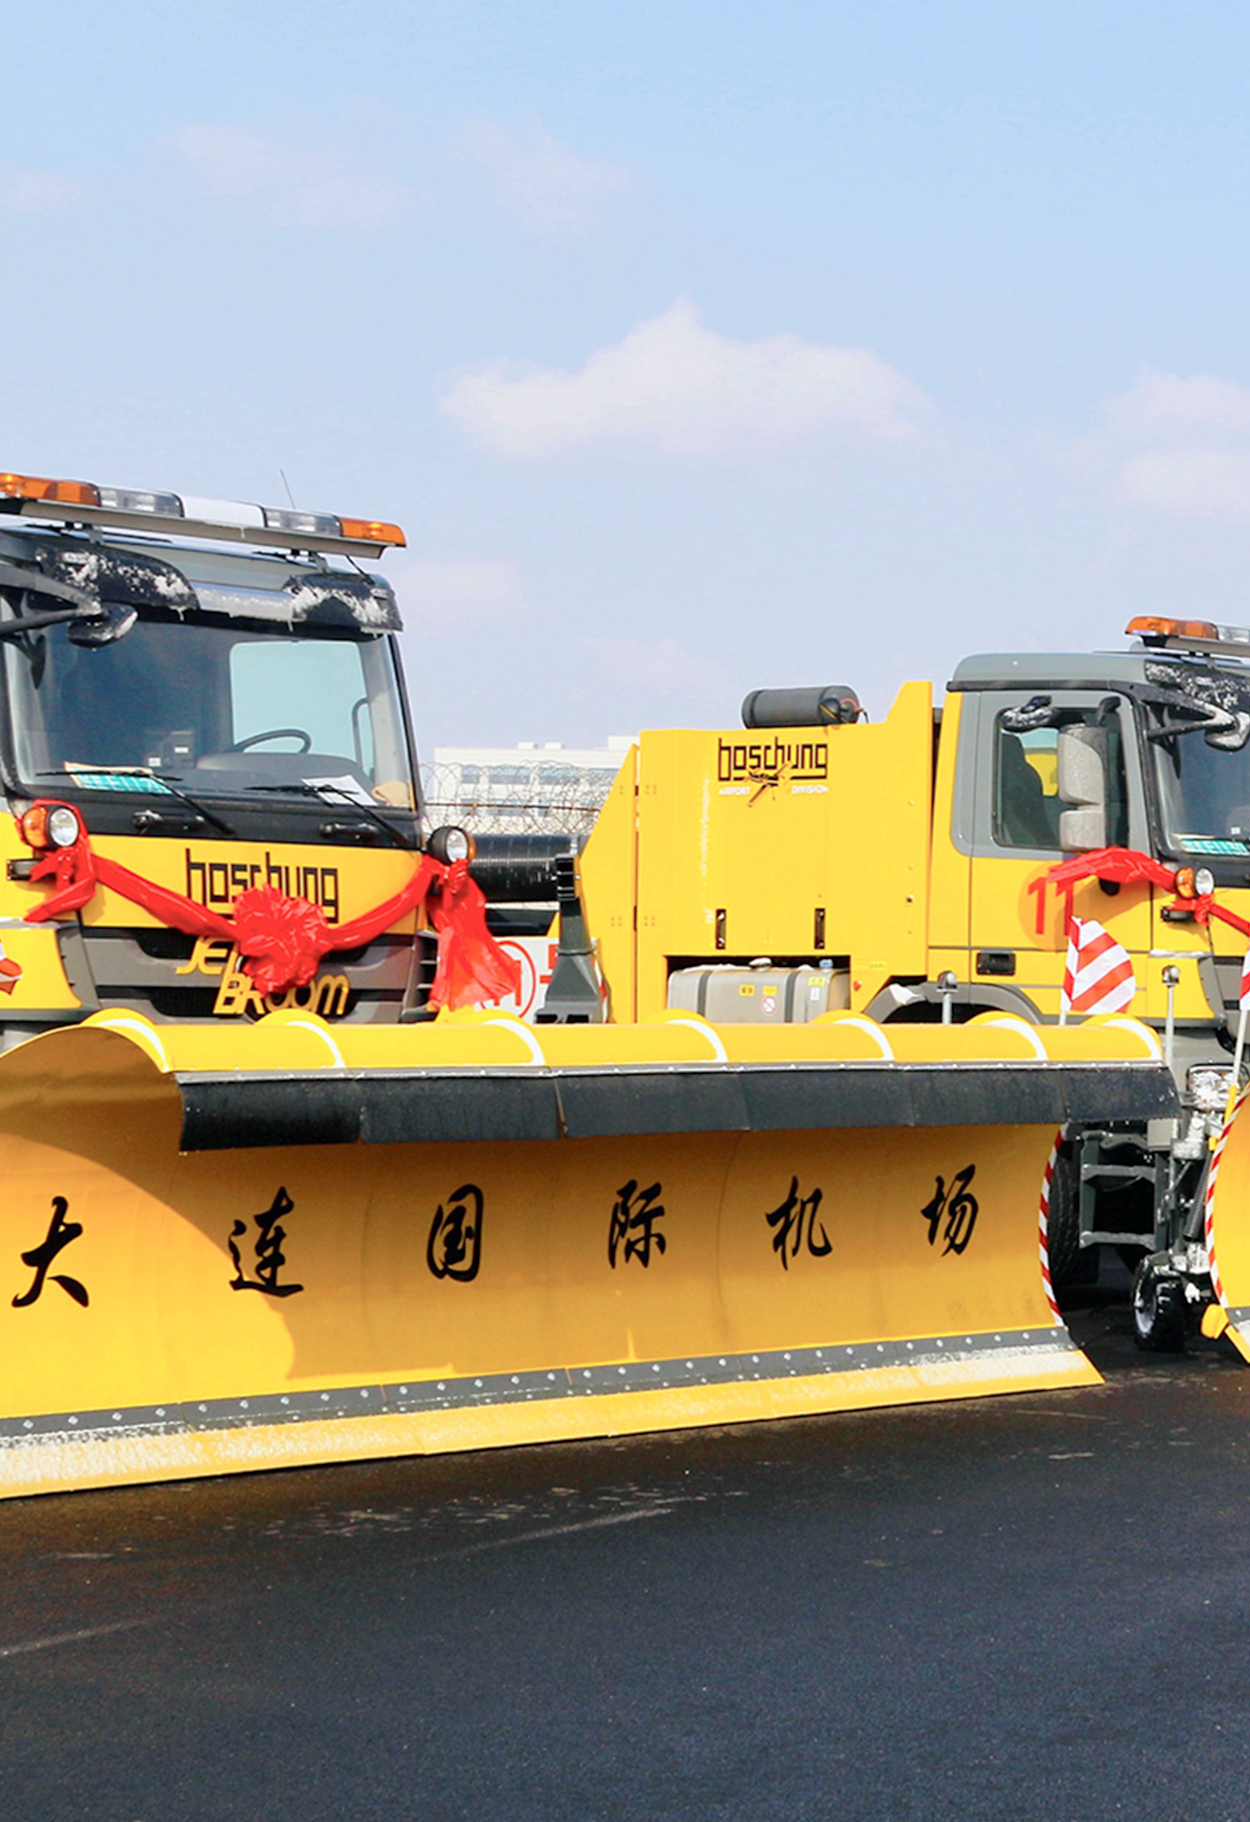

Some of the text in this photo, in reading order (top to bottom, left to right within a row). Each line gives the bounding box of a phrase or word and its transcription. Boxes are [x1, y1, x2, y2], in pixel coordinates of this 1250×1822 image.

[717, 736, 828, 782] boschung
[1027, 876, 1074, 936] 11
[12, 1163, 979, 1307] 大连国际机场
